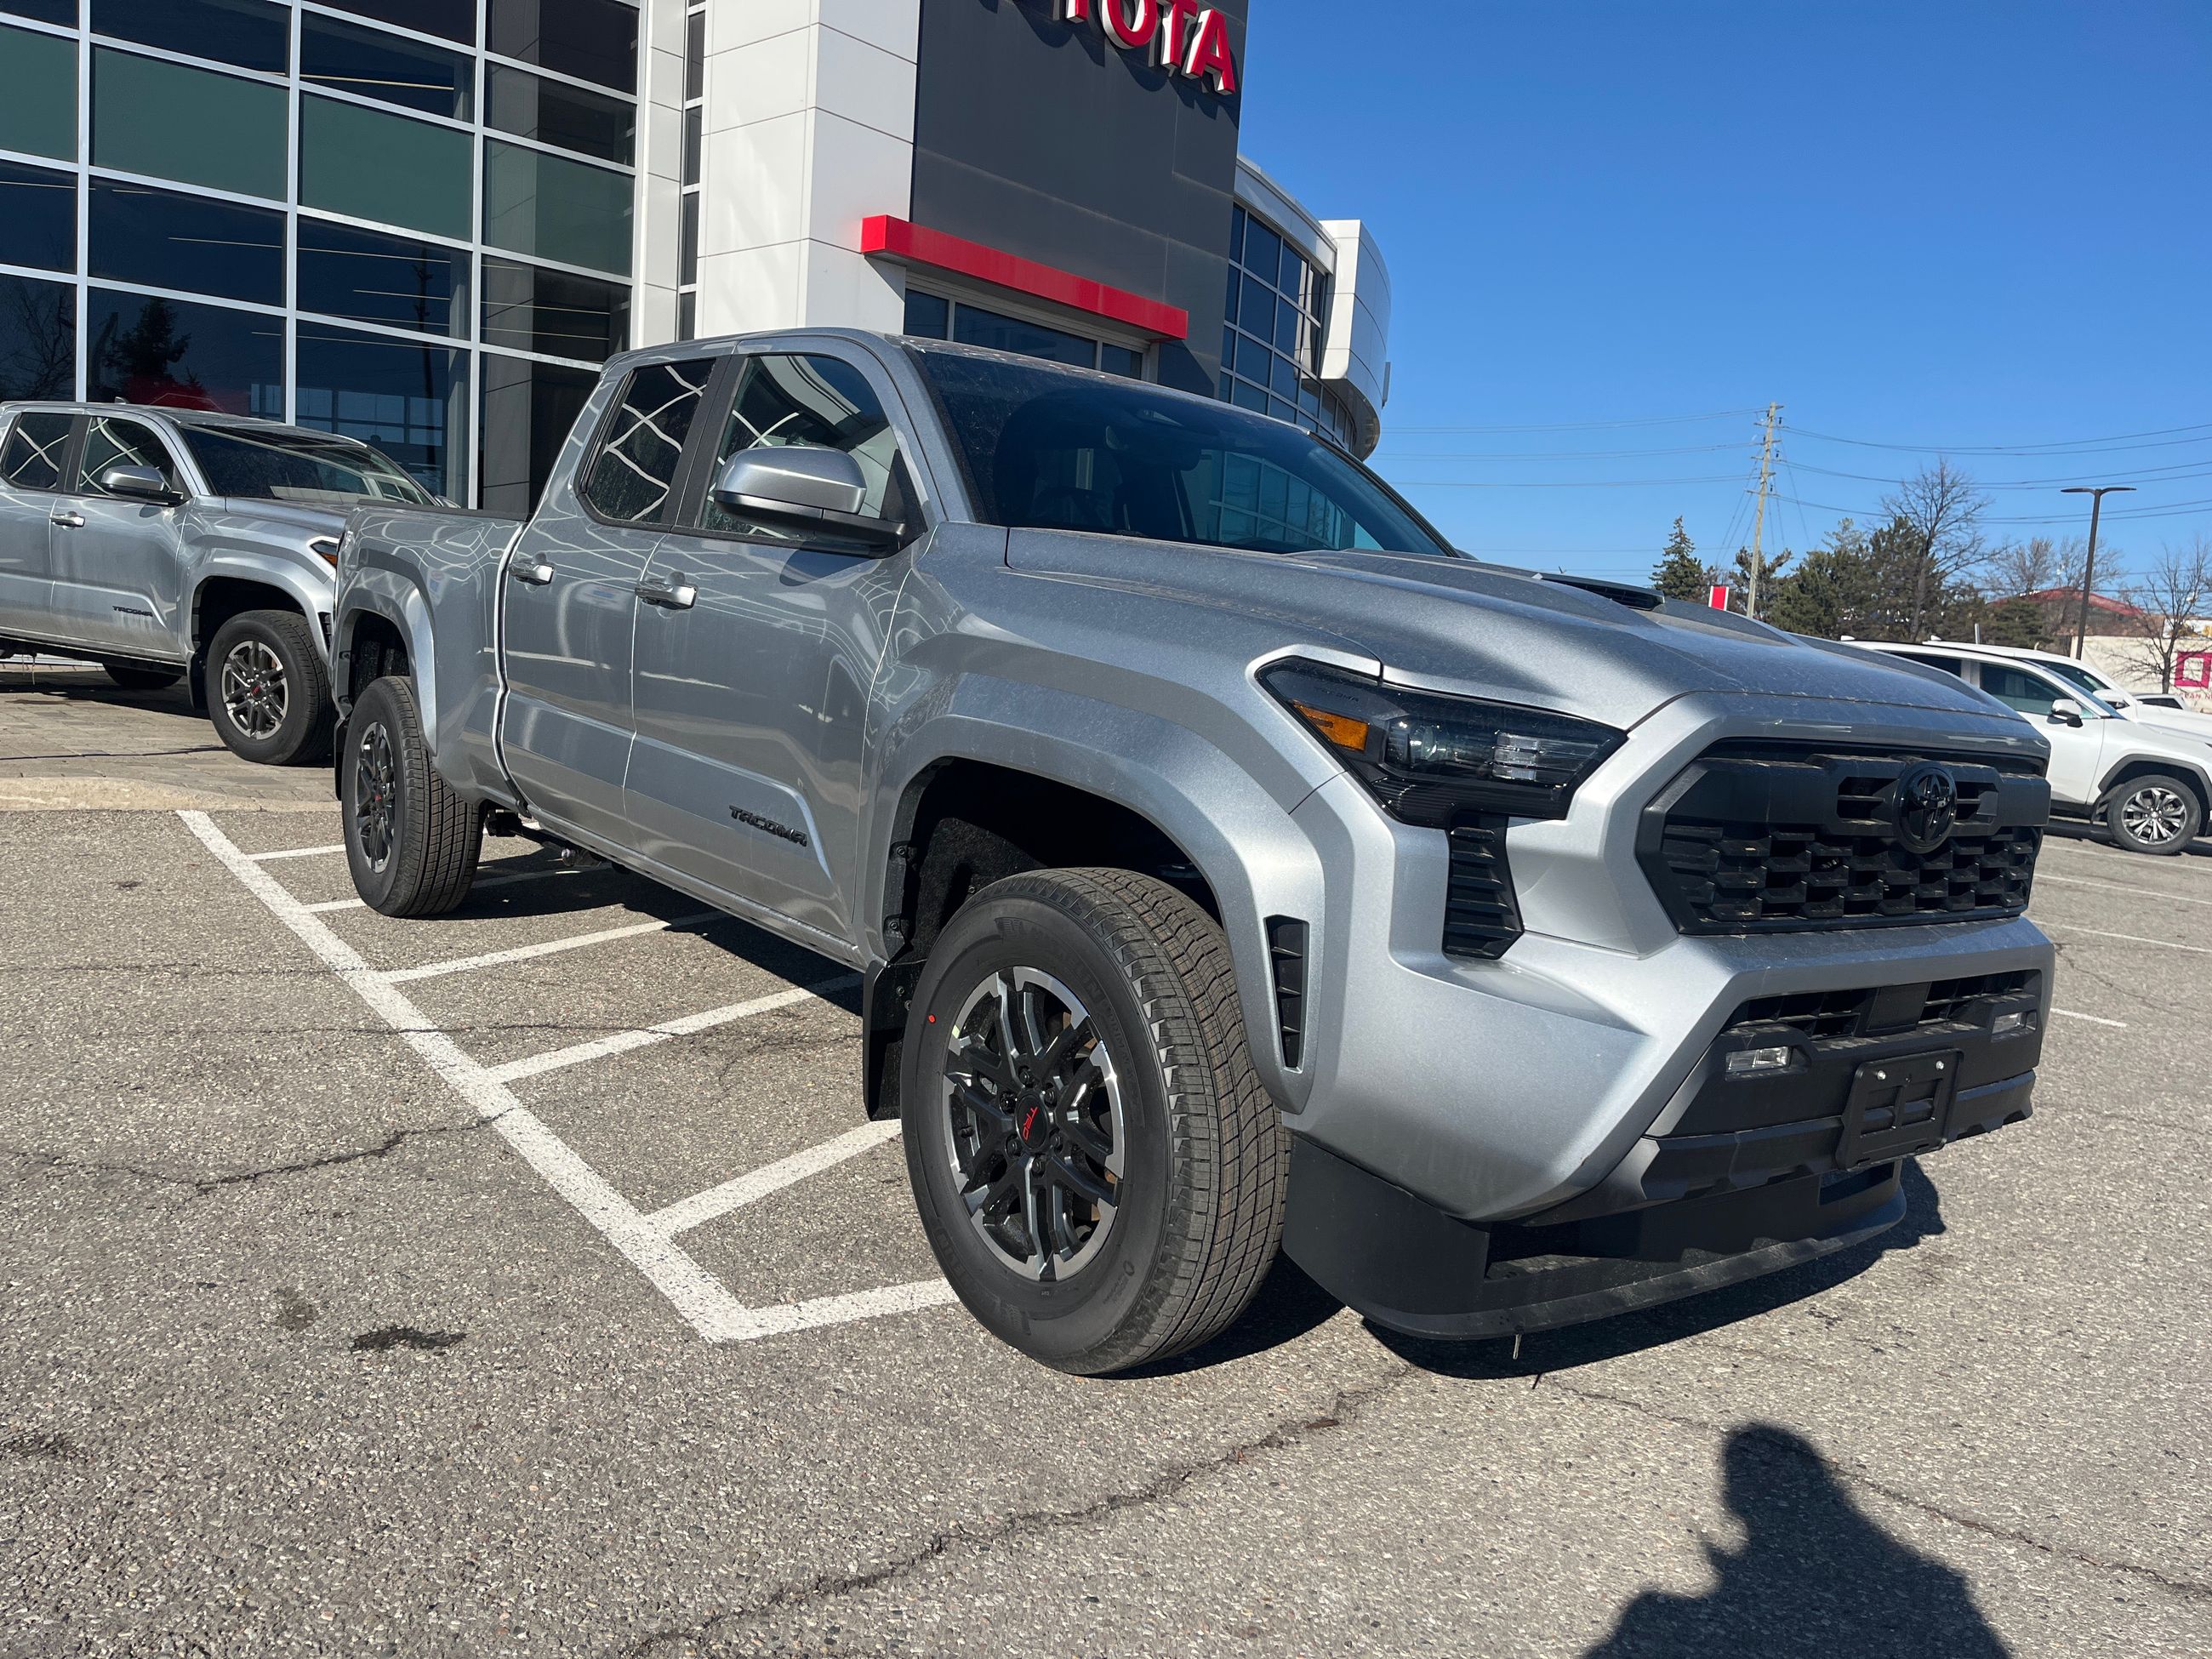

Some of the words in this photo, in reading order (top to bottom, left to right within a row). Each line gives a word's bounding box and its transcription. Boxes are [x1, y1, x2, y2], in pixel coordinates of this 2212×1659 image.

[111, 605, 153, 617] TACOMA
[729, 805, 807, 847] TACOMA
[1023, 1106, 1038, 1141] TRD
